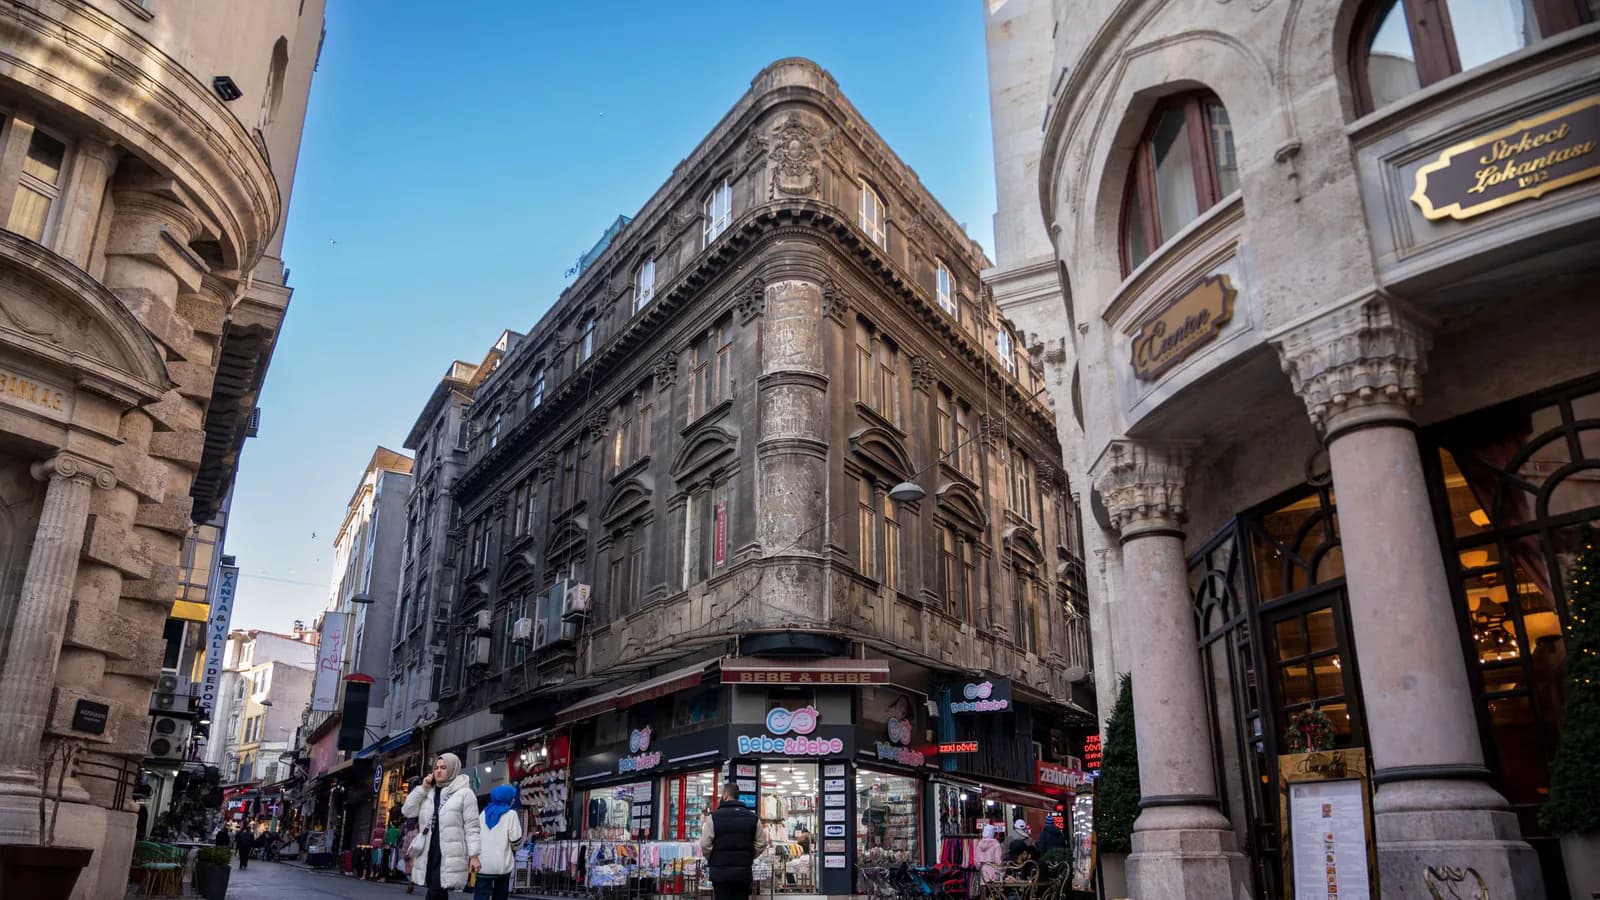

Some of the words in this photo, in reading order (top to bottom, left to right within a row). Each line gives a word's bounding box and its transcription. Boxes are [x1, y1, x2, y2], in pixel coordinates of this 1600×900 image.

[1480, 123, 1569, 164] Sirkeci
[1518, 170, 1549, 188] 1912
[740, 672, 792, 682] BEBE
[799, 673, 812, 682] &
[820, 673, 871, 683] BEBE
[951, 699, 1008, 713] Bebe&Bebe
[738, 734, 843, 755] Bebe&Bebe
